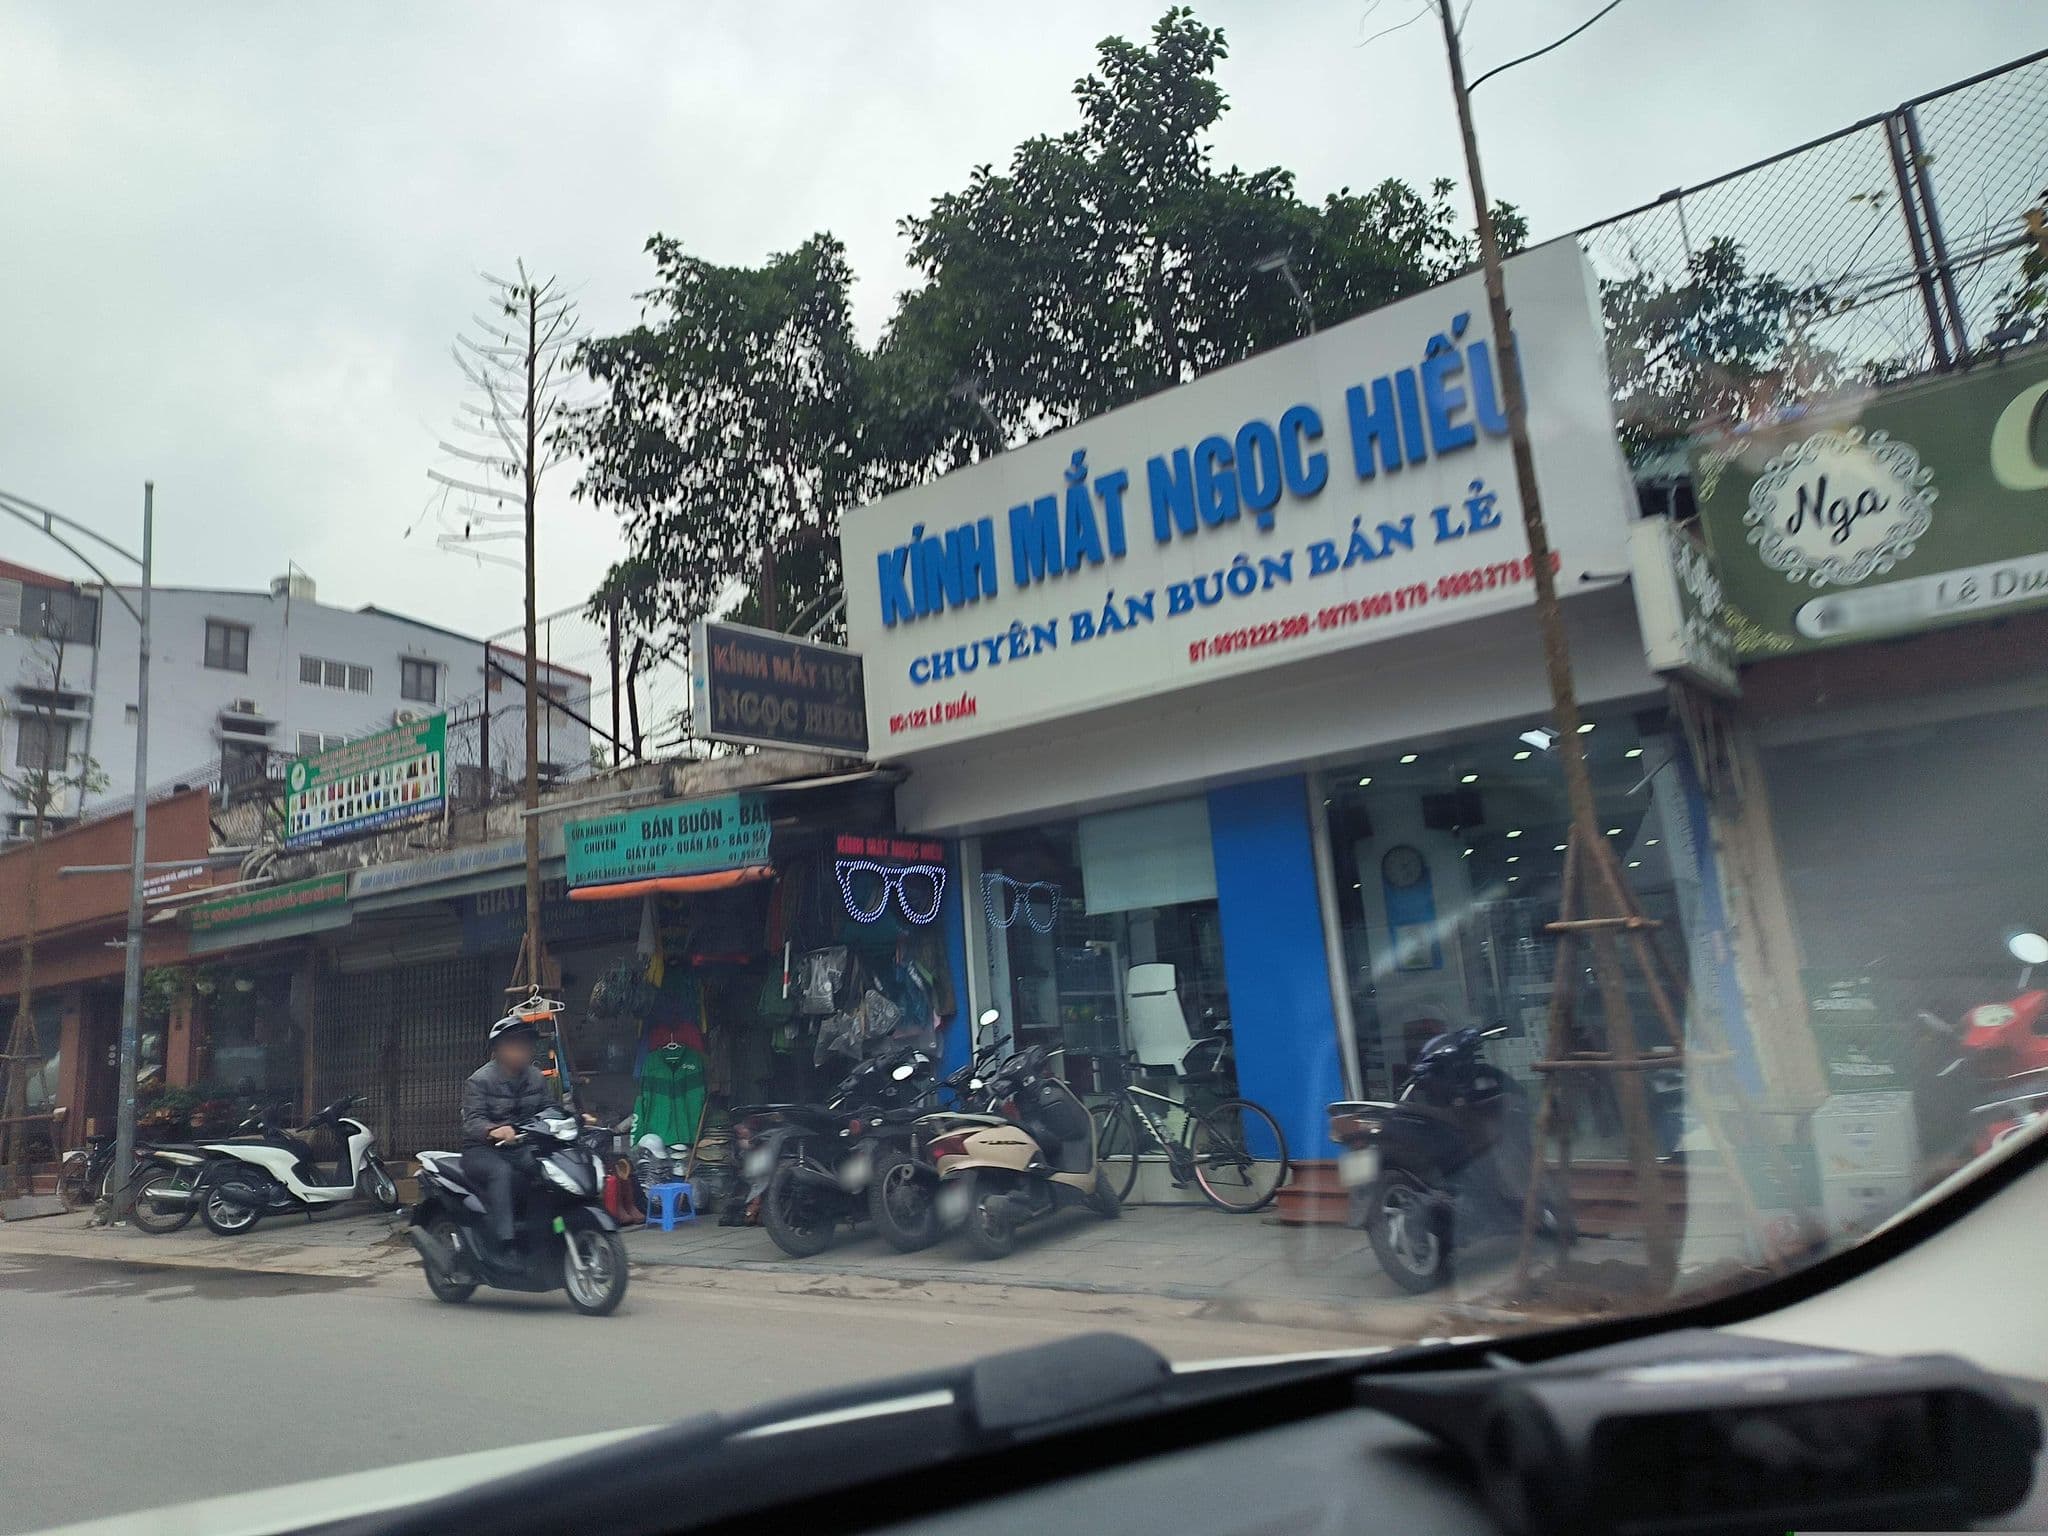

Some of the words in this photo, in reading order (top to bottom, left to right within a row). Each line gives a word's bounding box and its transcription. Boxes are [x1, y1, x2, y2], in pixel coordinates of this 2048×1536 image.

[877, 522, 998, 630] KÍNH
[1009, 449, 1129, 588] MẮT
[1147, 405, 1331, 544] NGỌC
[1346, 310, 1528, 481] HIẾU
[1786, 472, 1890, 545] Nga
[909, 619, 1058, 687] CHUYÊN
[1070, 588, 1156, 645] BÁN
[1166, 551, 1295, 616] BUÔN
[1306, 514, 1415, 580] BÁN
[1429, 476, 1503, 545] LẺ
[714, 641, 768, 682] KÍNH
[717, 687, 799, 737] NGỌC
[642, 815, 674, 840] BÁN
[678, 808, 722, 835] BUÔN
